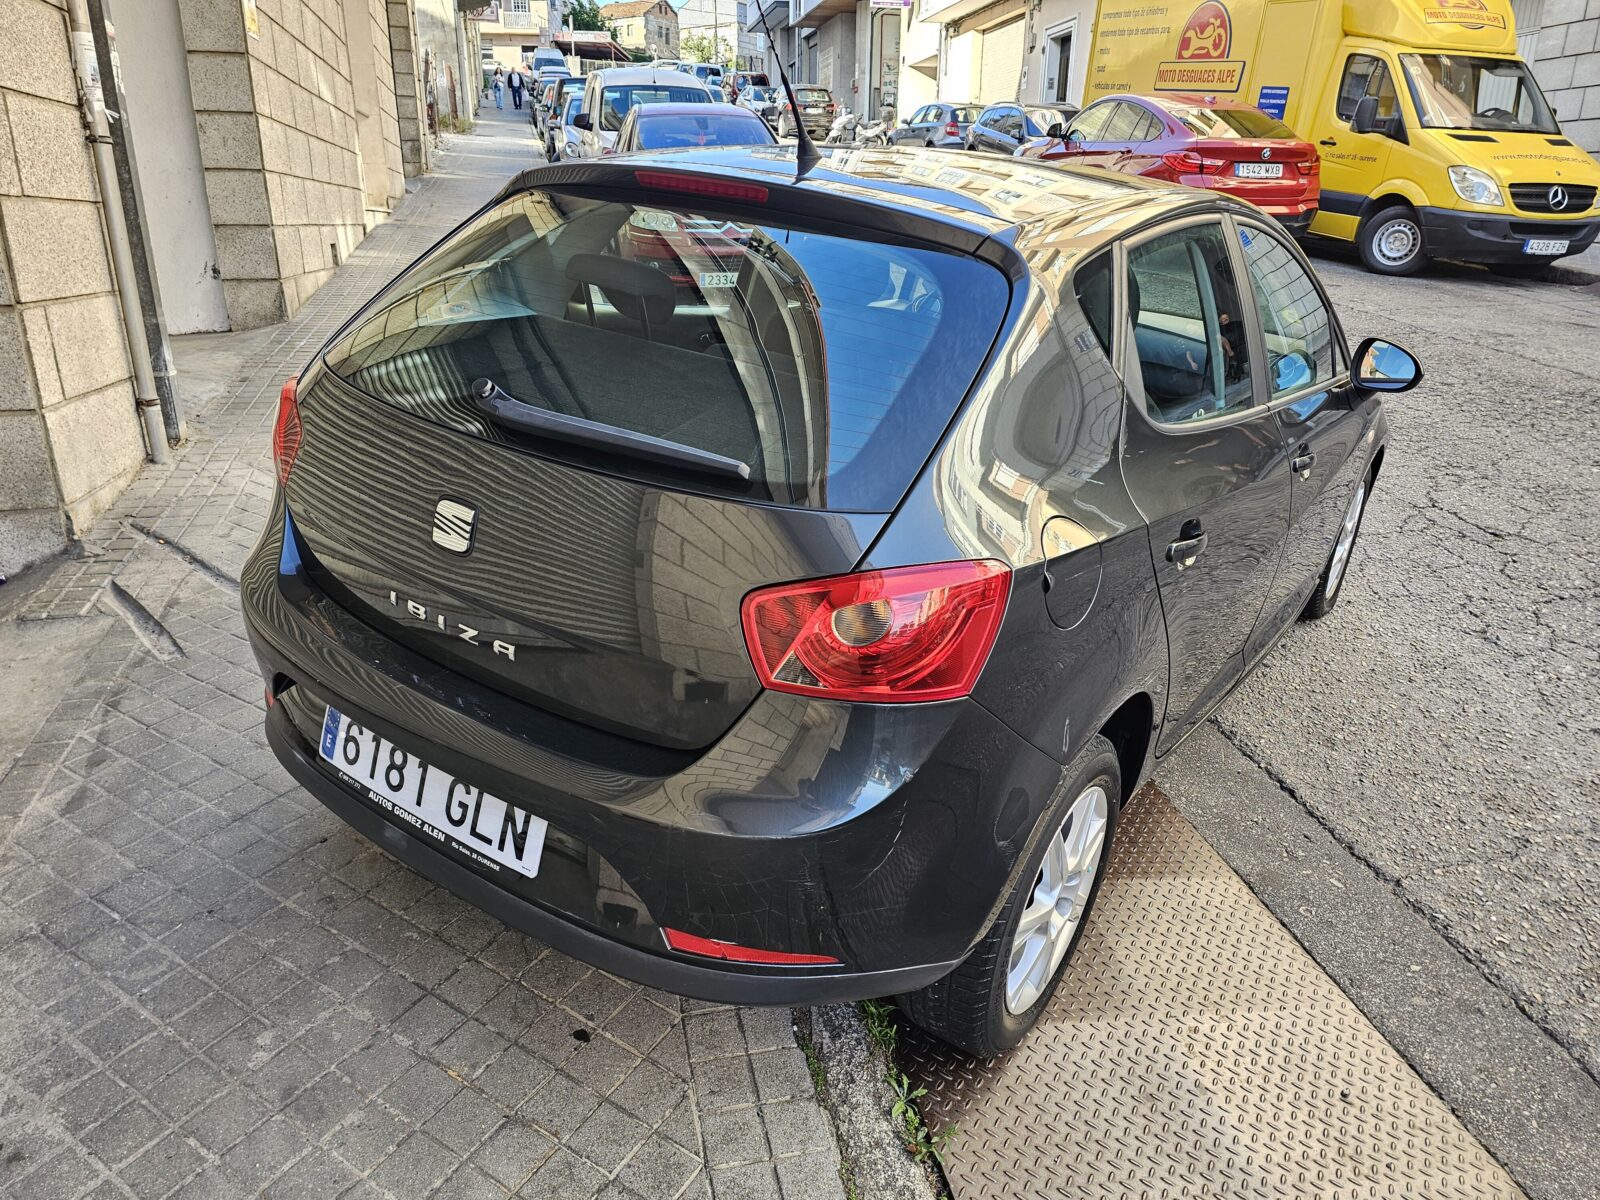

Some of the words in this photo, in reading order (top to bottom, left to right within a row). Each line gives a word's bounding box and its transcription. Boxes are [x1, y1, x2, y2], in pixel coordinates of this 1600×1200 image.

[1426, 11, 1447, 19] MOTO
[1448, 12, 1485, 21] DESGUACES
[1486, 15, 1501, 24] ALPE
[1158, 70, 1176, 83] MOTO
[1177, 69, 1216, 83] DESGUACES
[1216, 69, 1236, 83] ALPE
[1241, 165, 1262, 175] 1542
[1265, 165, 1280, 175] MXB
[1530, 242, 1550, 251] 4328
[1551, 242, 1567, 252] FZH
[707, 274, 735, 286] 2334
[390, 590, 515, 662] IBIZA
[326, 733, 333, 748] E
[343, 719, 429, 808] 6181
[445, 778, 532, 862] GLN
[368, 790, 393, 811] AUTOS
[394, 805, 422, 829] GOMEZ
[422, 821, 446, 842] ALEN
[477, 855, 500, 872] OURENSE
